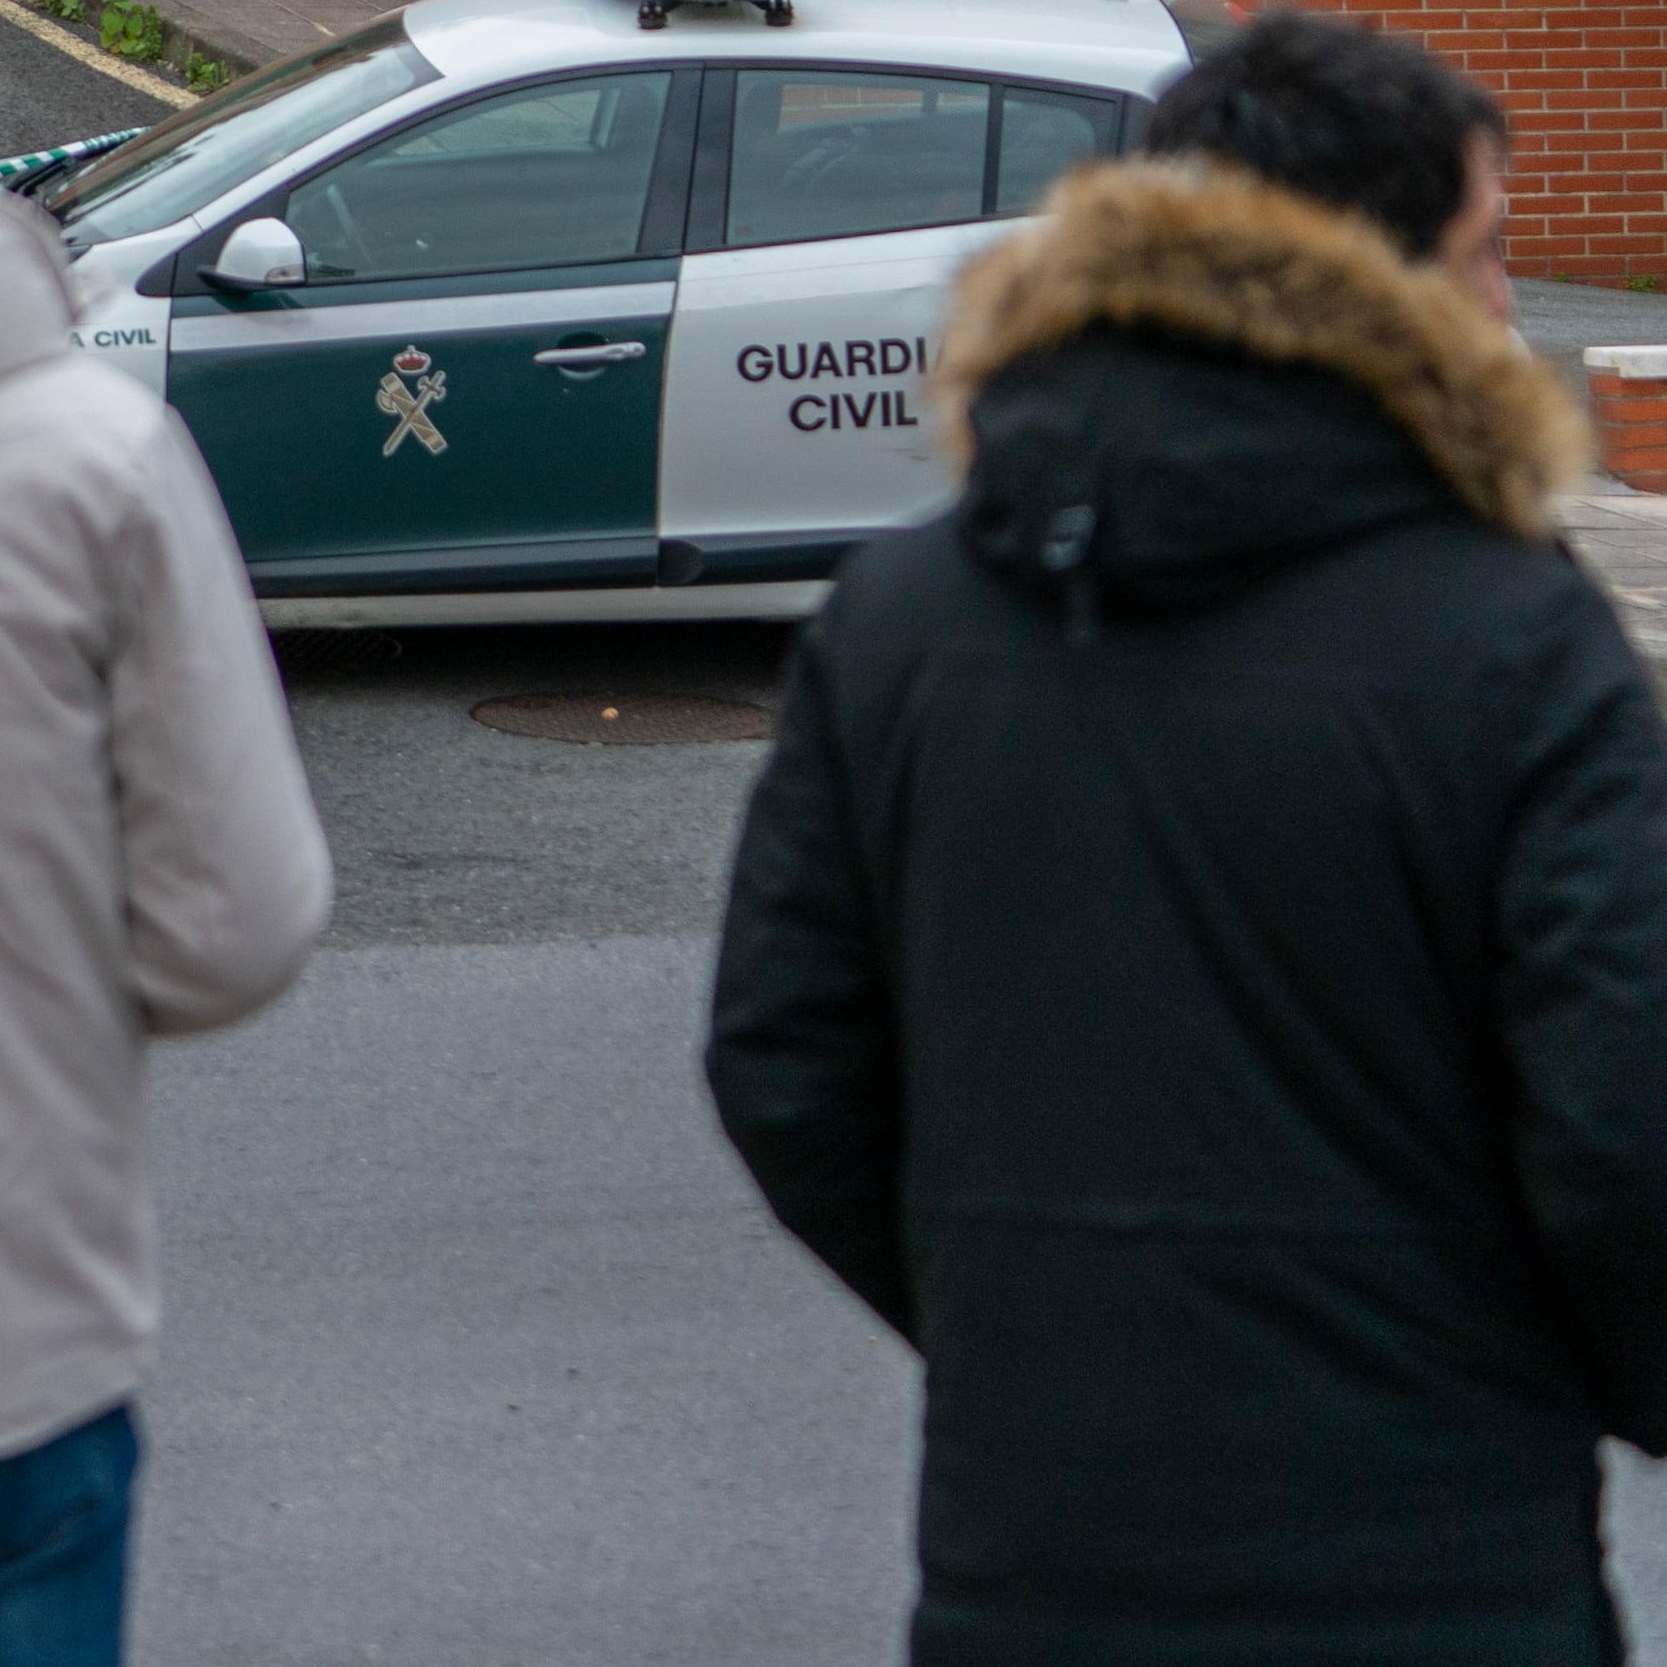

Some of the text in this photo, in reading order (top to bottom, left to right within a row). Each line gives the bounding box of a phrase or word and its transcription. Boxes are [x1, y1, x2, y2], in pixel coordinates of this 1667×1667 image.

[94, 328, 157, 348] CIVIL
[736, 336, 935, 383] GUARDI
[788, 390, 919, 432] CIVIL
